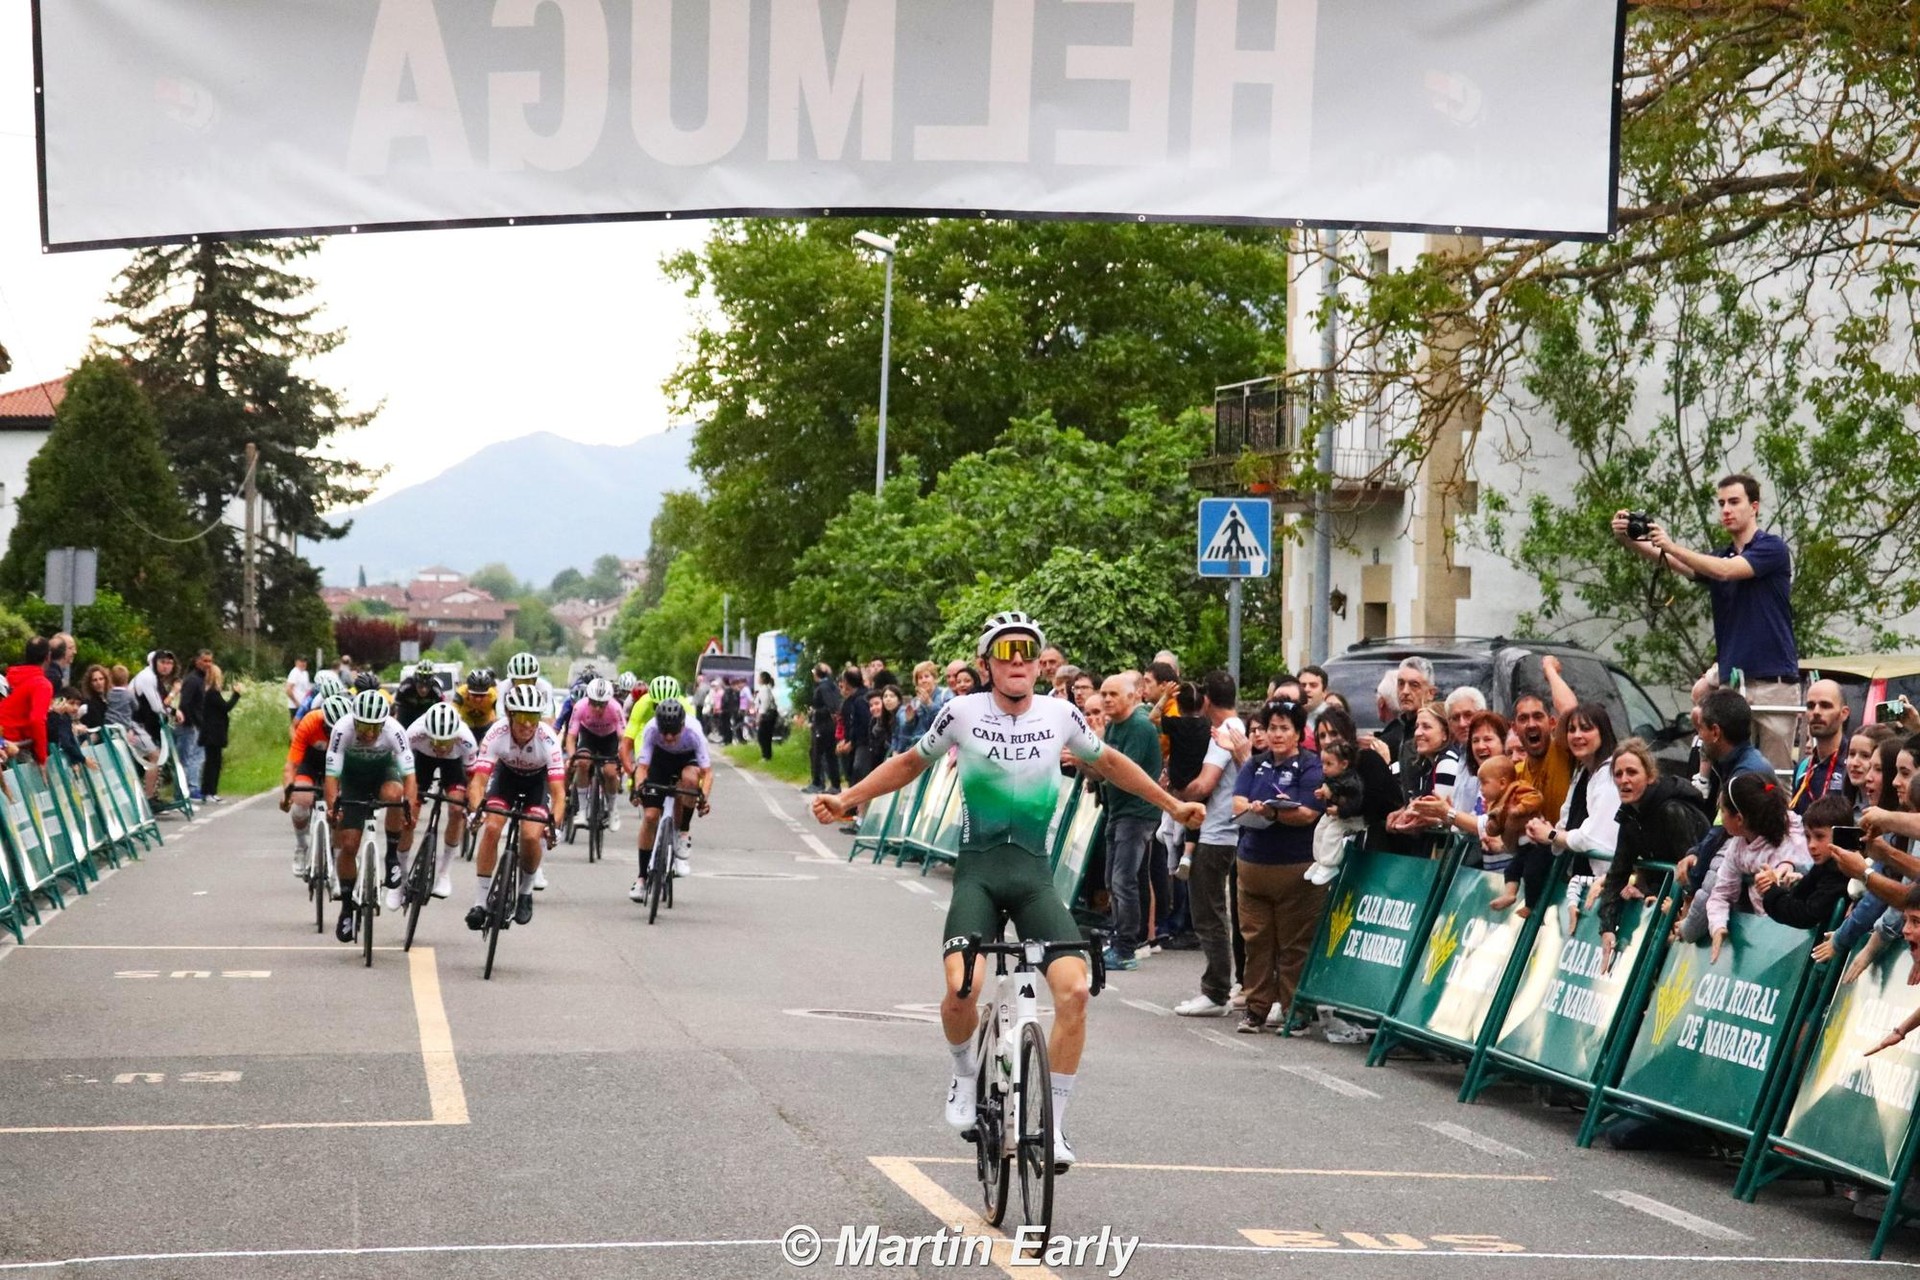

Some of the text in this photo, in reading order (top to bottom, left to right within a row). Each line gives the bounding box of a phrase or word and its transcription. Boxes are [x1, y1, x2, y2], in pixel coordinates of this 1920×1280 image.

[972, 727, 1054, 744] CAJA RURAL
[987, 746, 1041, 761] ALEA
[1356, 895, 1416, 931] CAJA RURAL
[1343, 929, 1407, 968] DE NAVARRA
[1559, 938, 1591, 976] CAJA
[1541, 978, 1566, 1013] DE
[1694, 973, 1780, 1025] CAJA RURAL
[1677, 1013, 1771, 1071] DE NAVARRA
[1237, 1228, 1526, 1251] BUS
